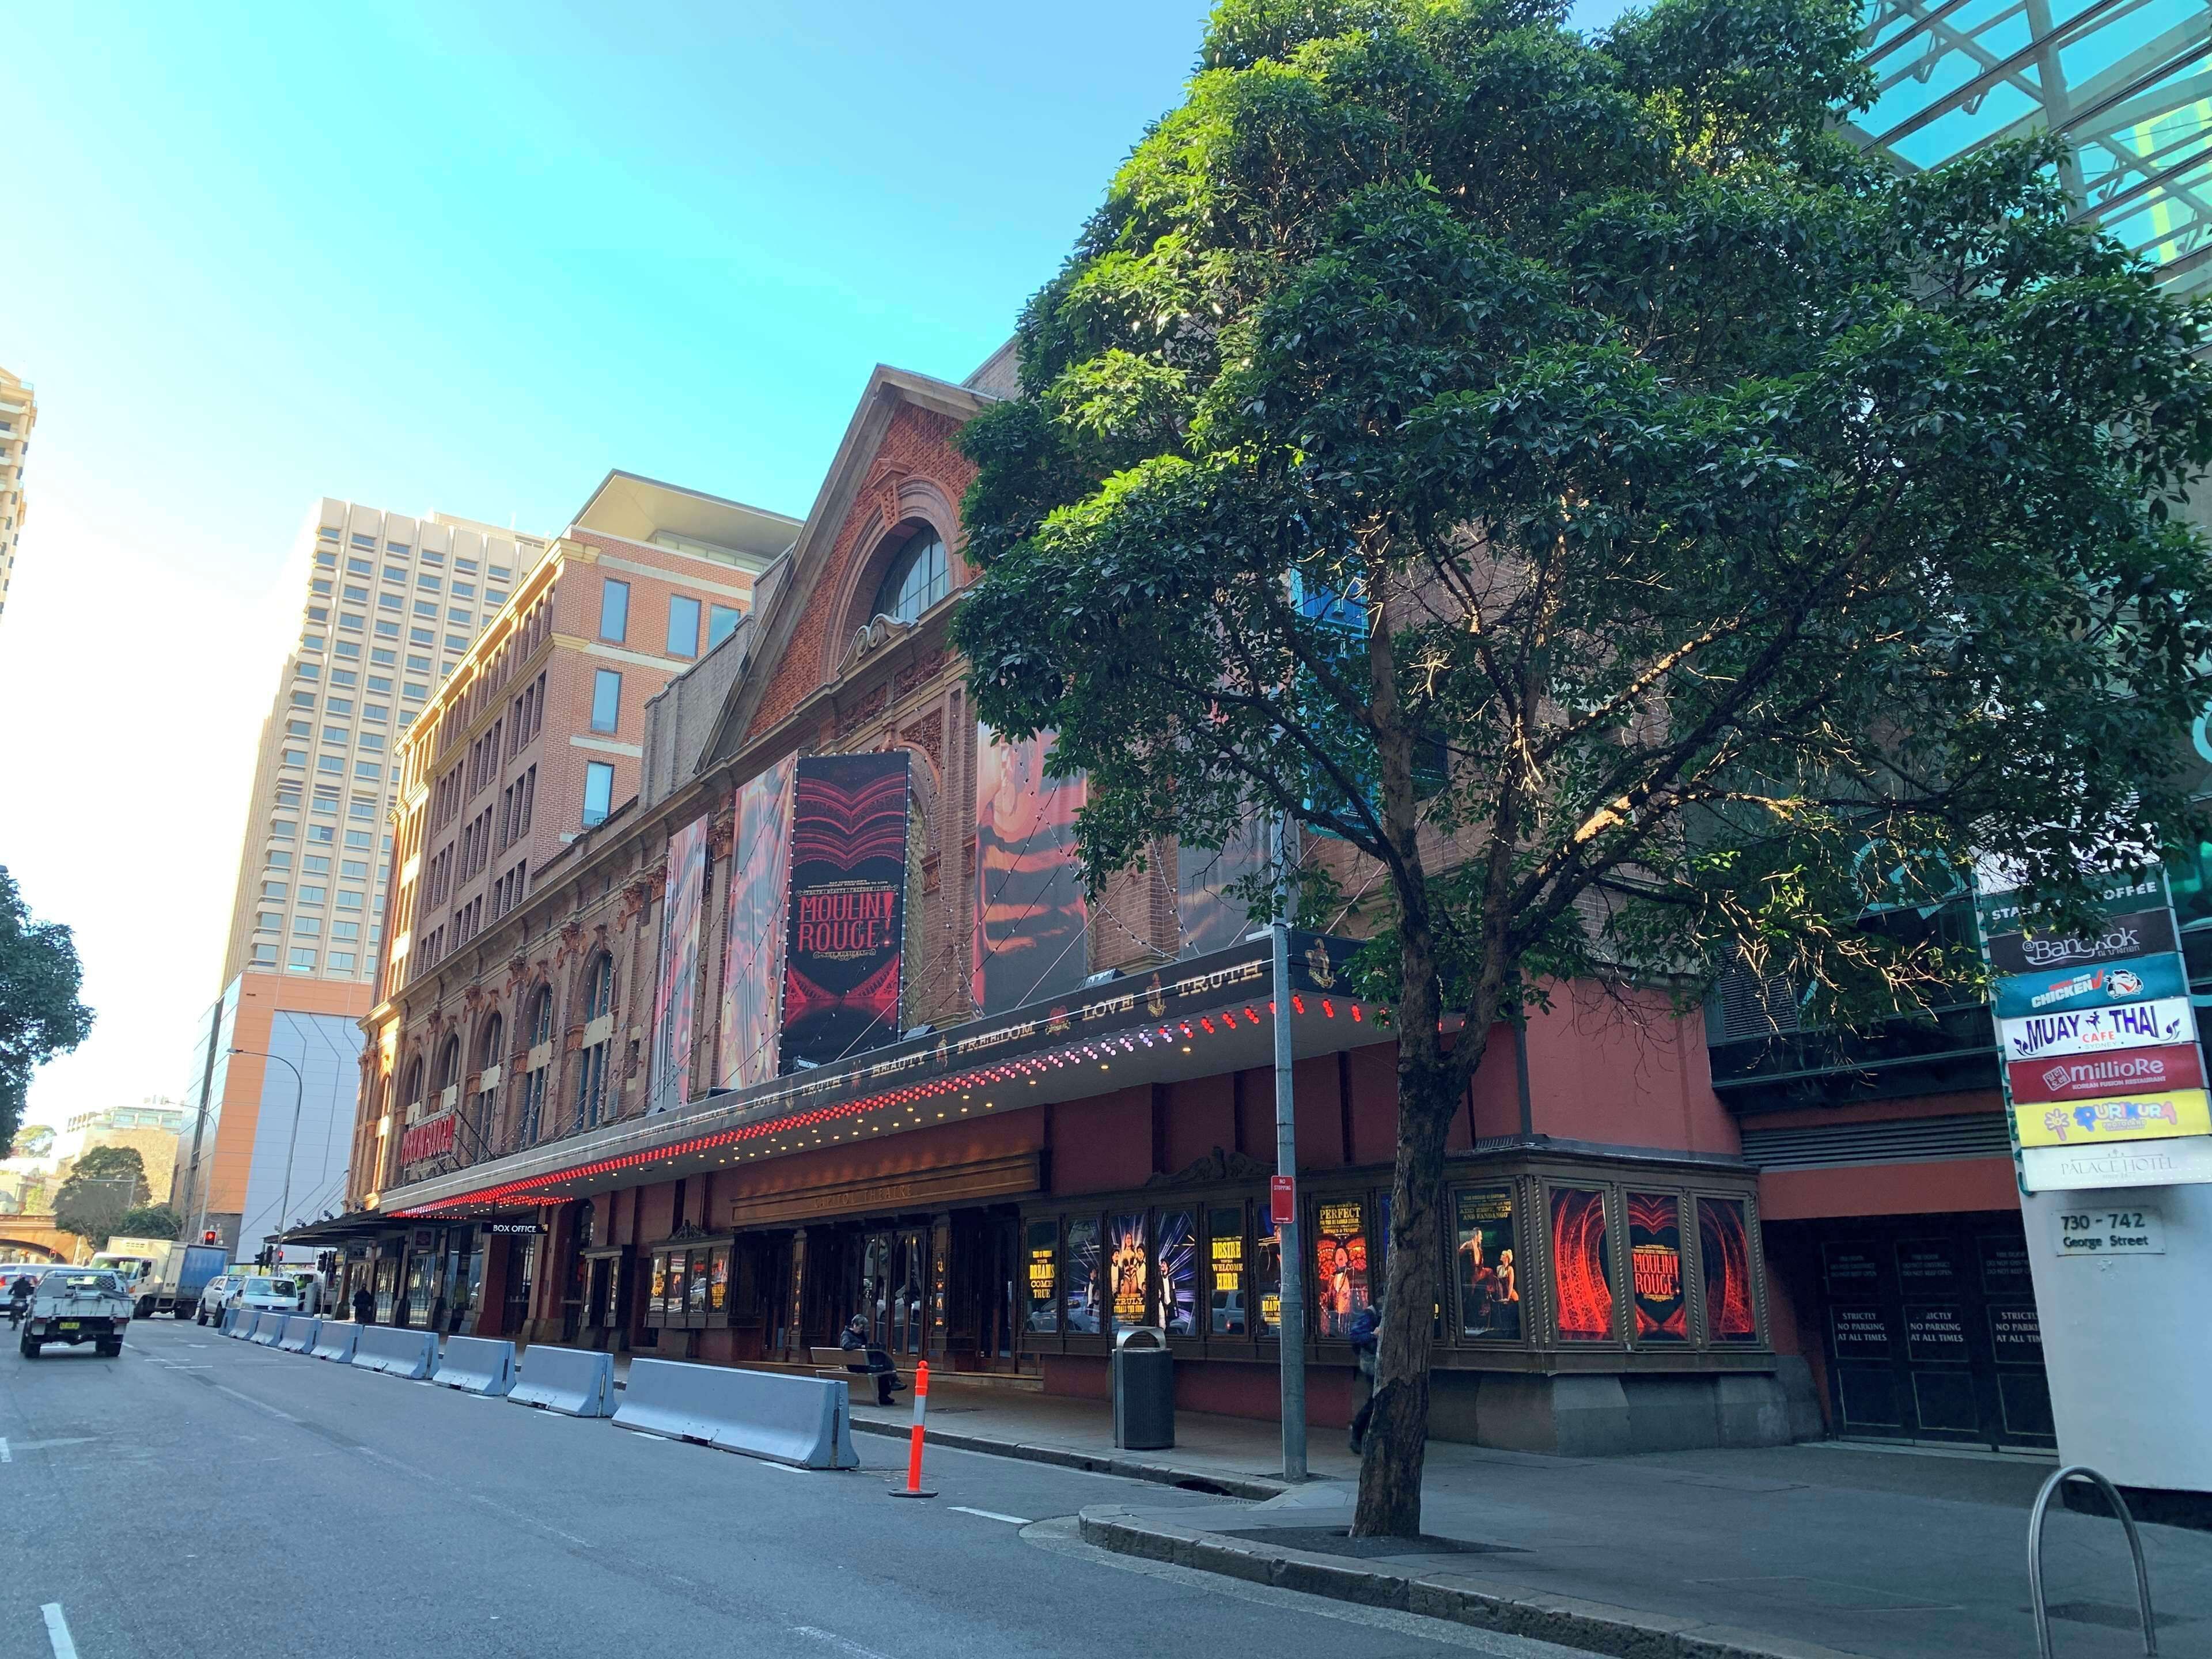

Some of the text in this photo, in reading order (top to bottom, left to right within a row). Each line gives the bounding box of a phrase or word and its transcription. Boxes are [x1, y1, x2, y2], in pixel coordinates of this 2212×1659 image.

[2093, 882, 2157, 902] OFFEE
[800, 892, 880, 923] MOULIN
[2031, 977, 2093, 1009] CHICKEN
[801, 1074, 843, 1097] TRUTH
[870, 1050, 929, 1078] BEAUTY
[956, 1020, 1036, 1055] FREEDOM
[1081, 993, 1134, 1021] LOVE
[1176, 959, 1263, 997] TRUTH
[2025, 1005, 2160, 1052] MUAY THAI
[2082, 1031, 2115, 1043] CAFE
[2084, 1041, 2118, 1050] SYDNEY
[2125, 1076, 2166, 1086] RESTAURANT
[2061, 1157, 2178, 1175] PALACE HOTEL
[815, 1184, 913, 1209] CAPITOL THEATRE
[1319, 1207, 1361, 1220] PERFECT
[2061, 1215, 2090, 1230] 730
[2108, 1213, 2145, 1229] 742
[2063, 1235, 2149, 1250] George Street
[1212, 1241, 1241, 1260] DESIRE
[1211, 1263, 1244, 1272] WELCOME
[1633, 1253, 1673, 1274] MOULIN
[1029, 1263, 1055, 1279] DREAMS
[1031, 1280, 1054, 1288] COME
[1216, 1272, 1238, 1290] HERE
[1033, 1289, 1051, 1298] TRUE
[1115, 1297, 1143, 1305] TRULY
[1262, 1300, 1281, 1312] BEAUT
[1925, 1323, 1961, 1331] PARKING
[2012, 1323, 2040, 1331] PARKI
[1938, 1334, 1964, 1342] TIMES
[2009, 1335, 2024, 1343] ALL
